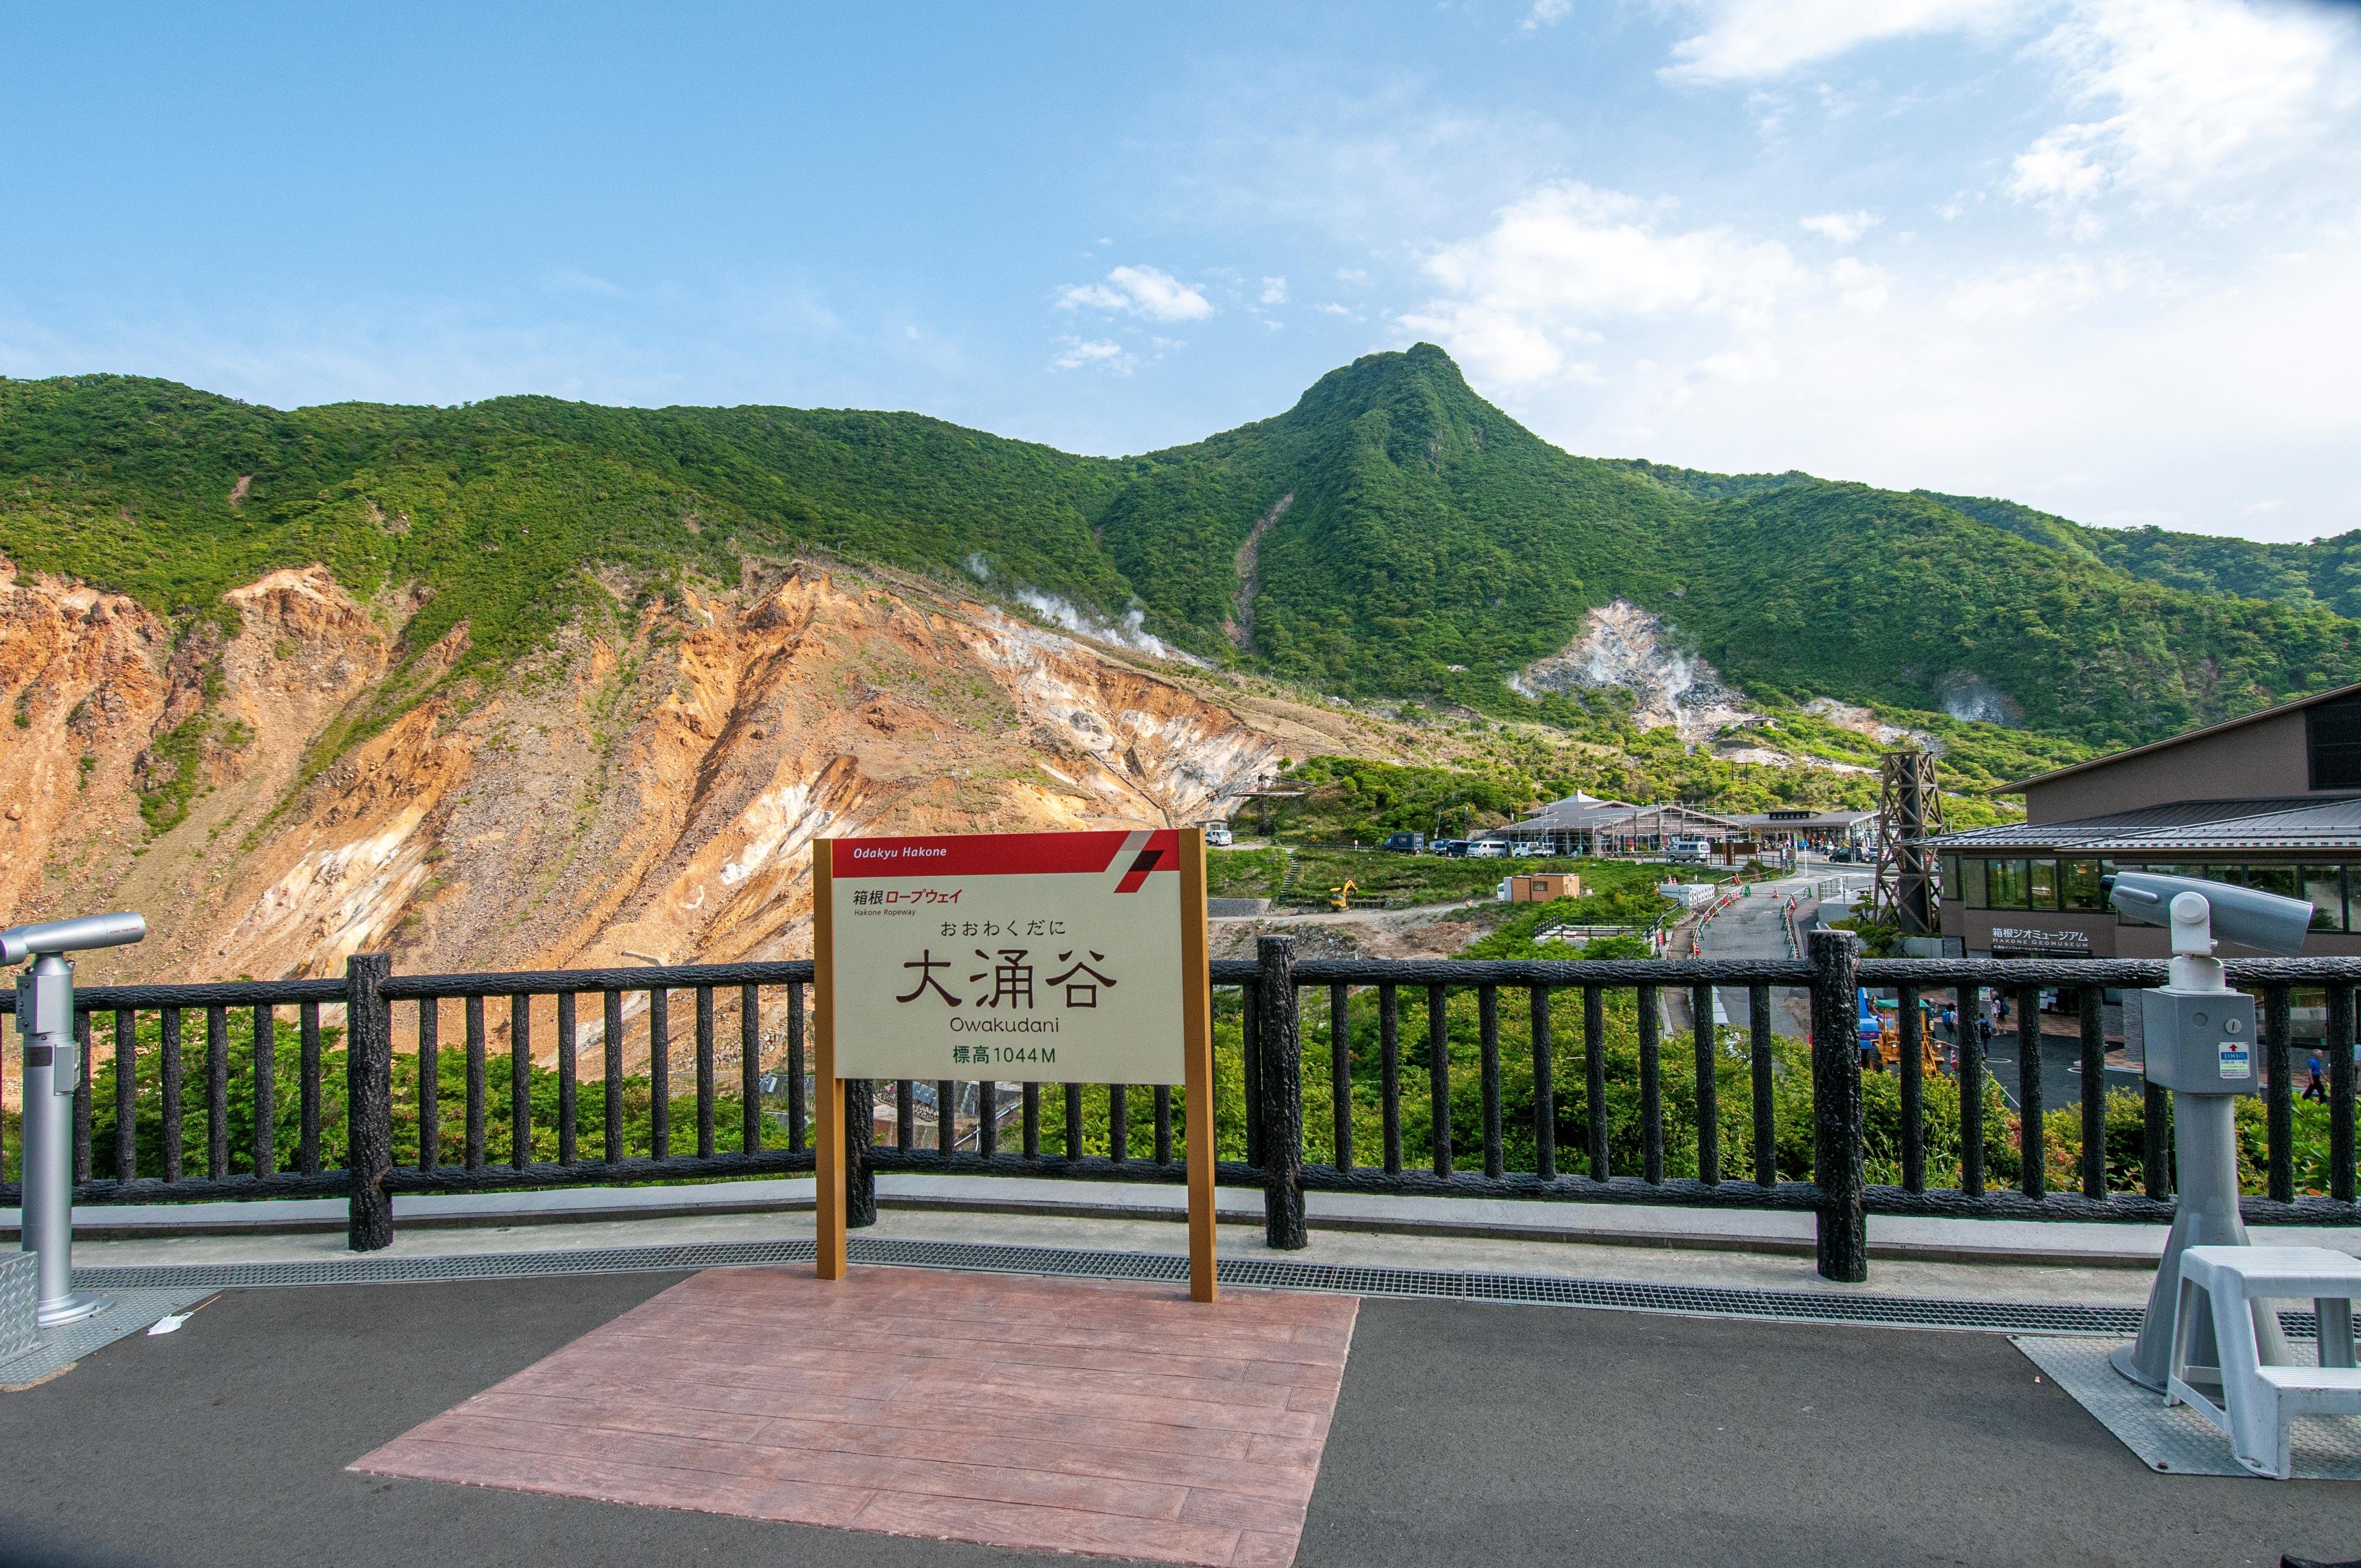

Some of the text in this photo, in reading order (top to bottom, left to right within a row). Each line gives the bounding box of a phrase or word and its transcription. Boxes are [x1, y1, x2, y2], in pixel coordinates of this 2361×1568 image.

[853, 847, 946, 860] Odakyu Hakone
[853, 889, 962, 905] 箱根ロープウェイ
[941, 920, 1066, 937] おおわくだに
[1992, 927, 2088, 941] 箱根ジオミュージアム
[2032, 939, 2088, 948] GEOMUSEUM
[896, 949, 1117, 1009] 大涌谷
[950, 1017, 1059, 1032] Owakudani
